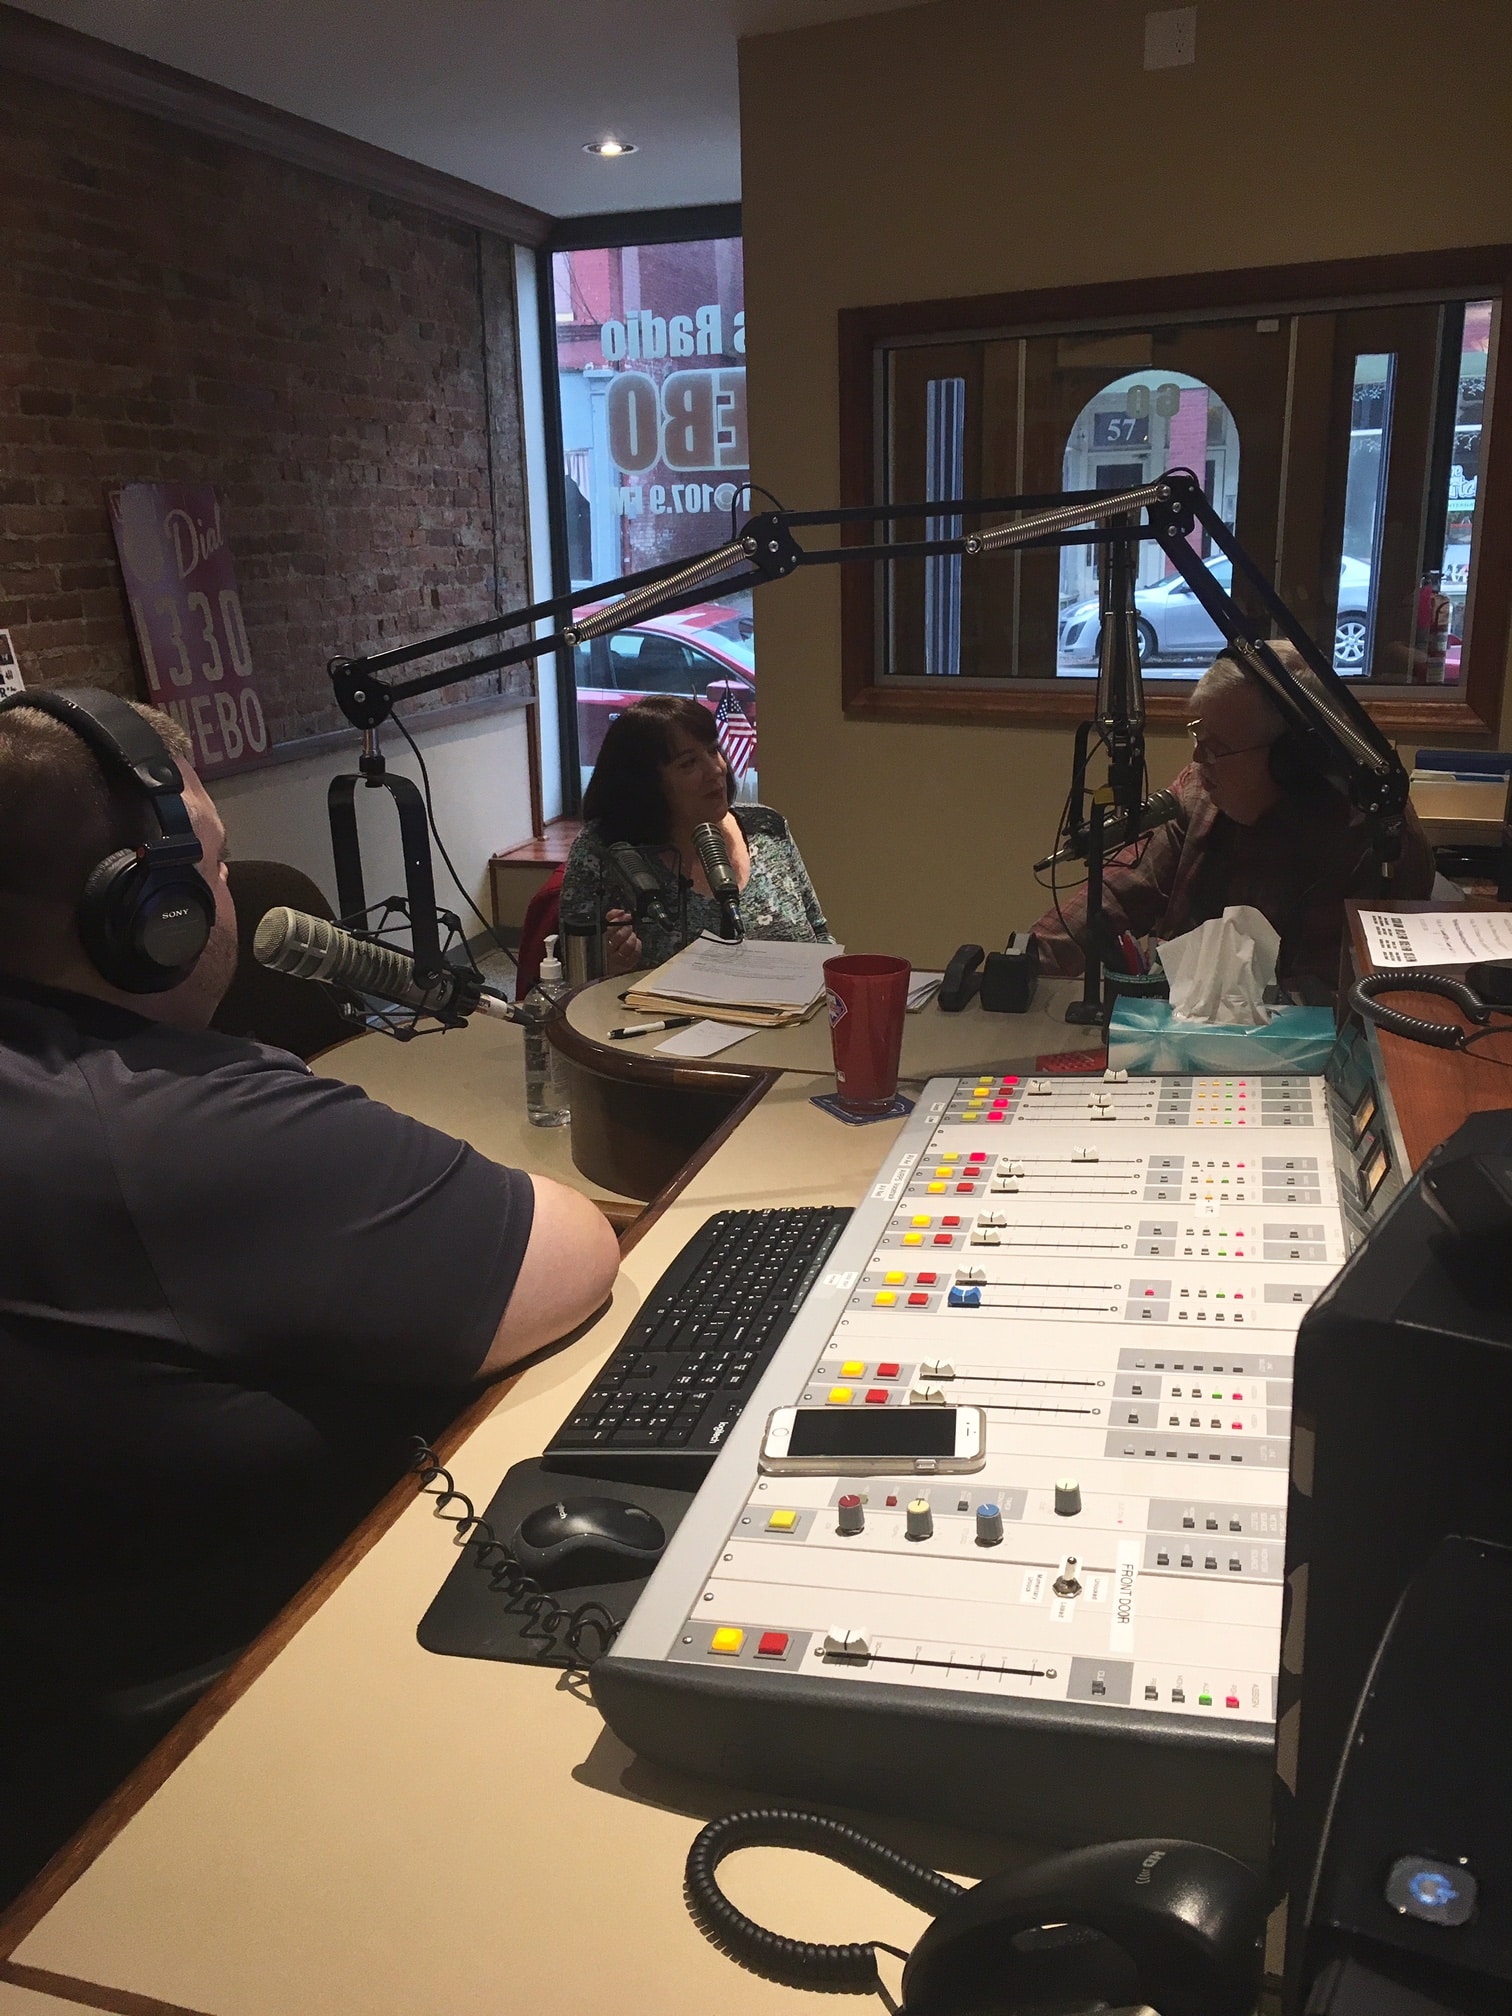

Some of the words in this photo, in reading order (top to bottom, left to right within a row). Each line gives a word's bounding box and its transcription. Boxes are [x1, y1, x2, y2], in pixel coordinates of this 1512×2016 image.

[1106, 418, 1136, 442] 57
[164, 502, 225, 579] Dial
[133, 589, 254, 691] 1330
[154, 687, 268, 769] WEBO
[161, 908, 190, 920] SONY
[708, 1420, 730, 1444] logitech
[1119, 1562, 1134, 1596] FRONT
[1116, 1598, 1132, 1625] DOOR
[1142, 1851, 1166, 1868] HD
